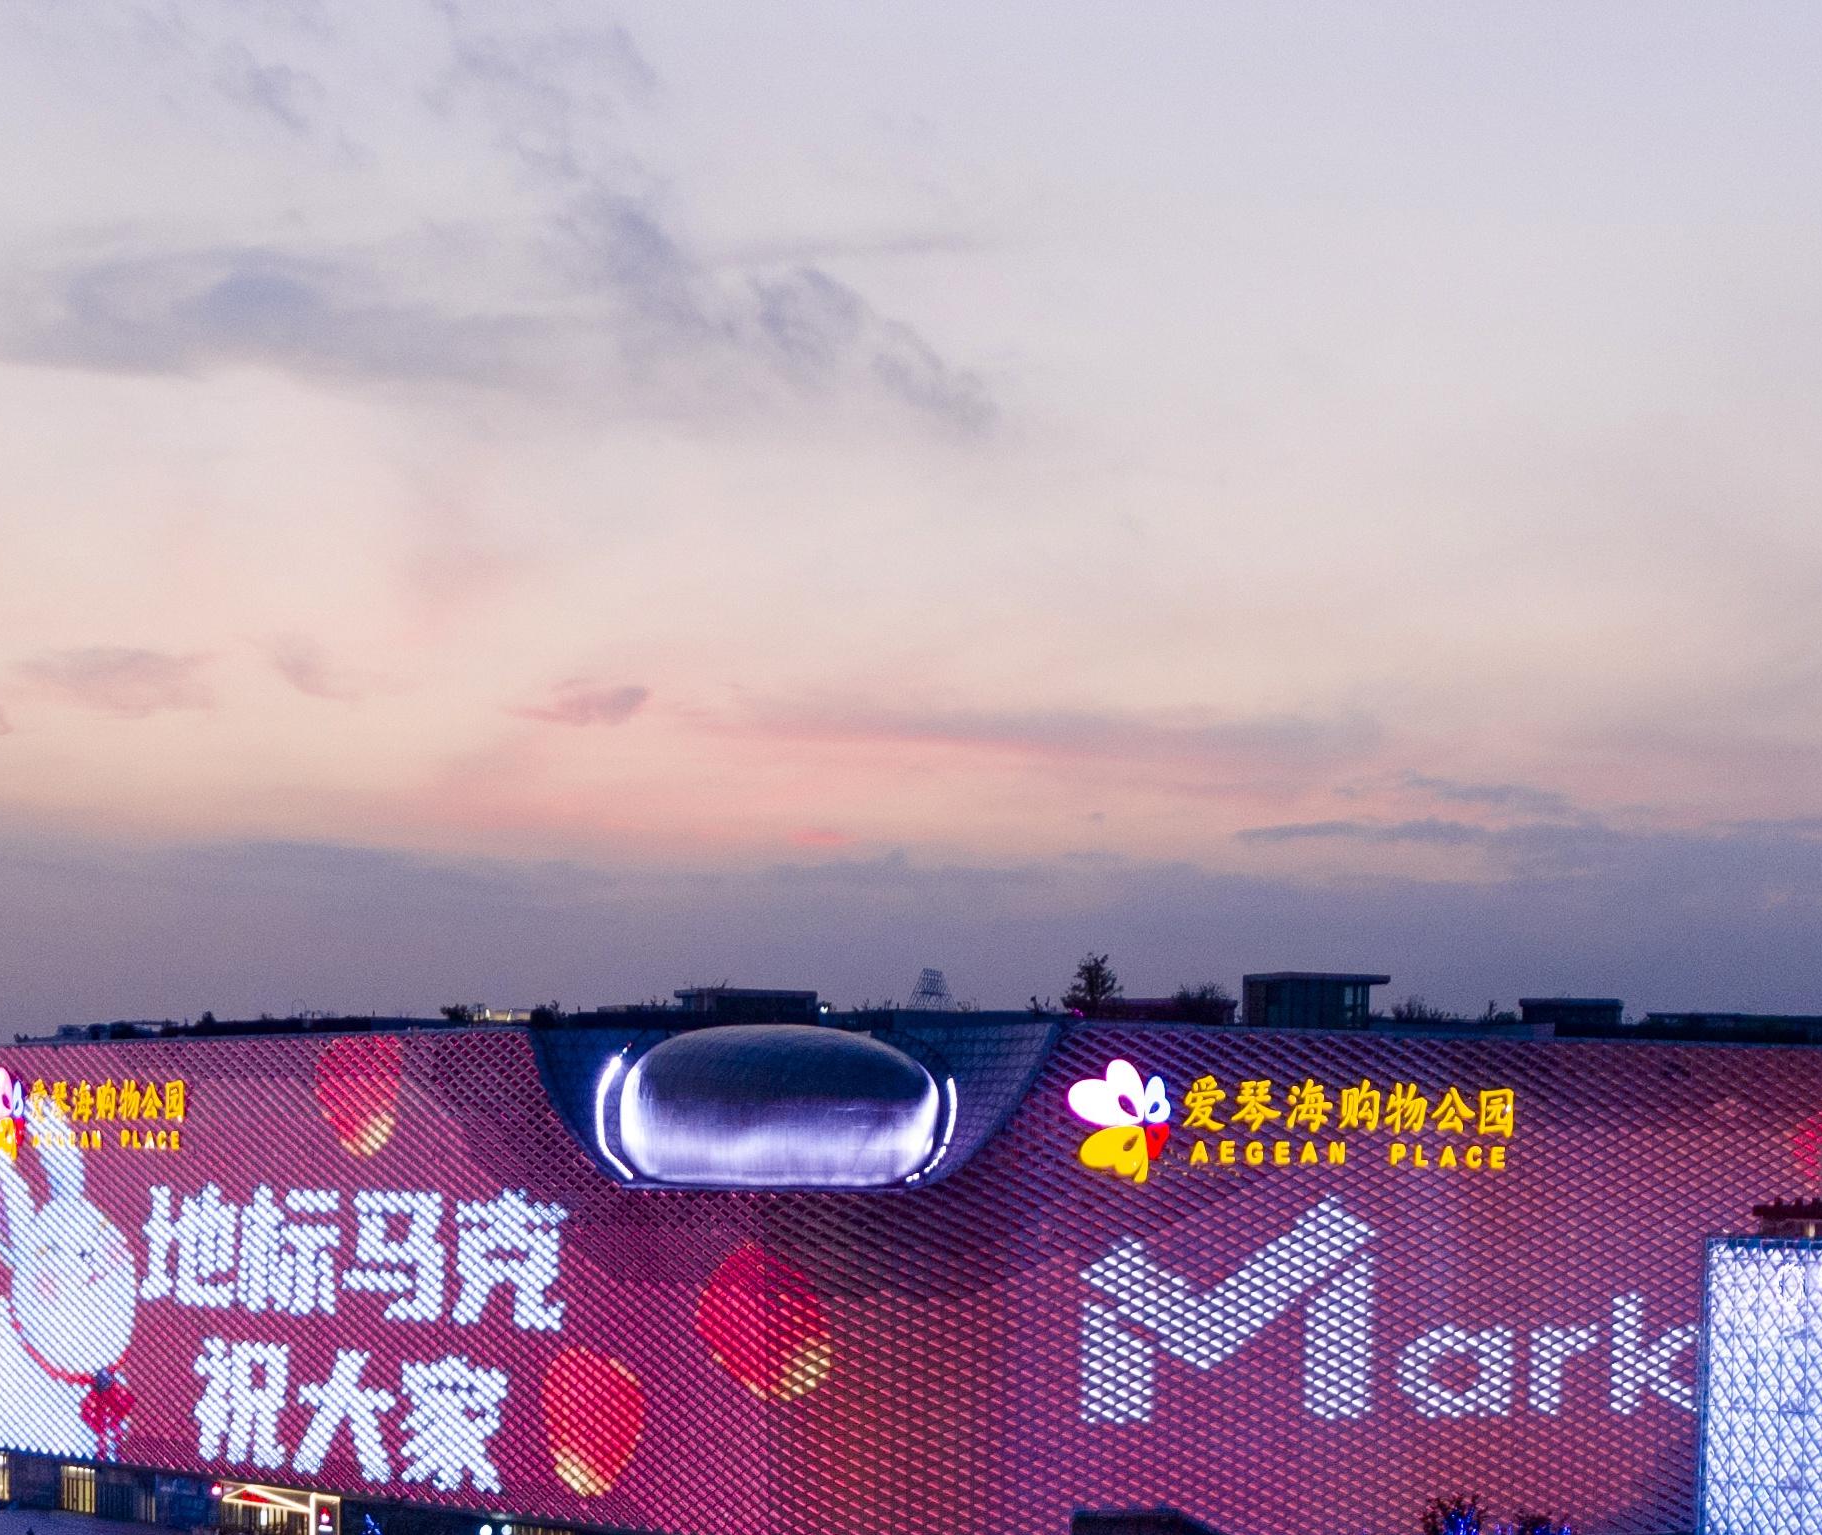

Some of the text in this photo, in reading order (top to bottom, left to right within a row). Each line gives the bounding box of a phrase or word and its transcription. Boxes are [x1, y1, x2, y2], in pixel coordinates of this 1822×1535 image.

[30, 1078, 186, 1122] 爱琴海购物公园
[1184, 1074, 1515, 1137] 爱琴海购物公园
[120, 1130, 180, 1150] PLACE
[1189, 1140, 1508, 1169] AEGEAN PLACE
[138, 1181, 568, 1332] 地标马克
[1080, 1195, 1700, 1424] Mark
[193, 1336, 509, 1495] 祝大家
